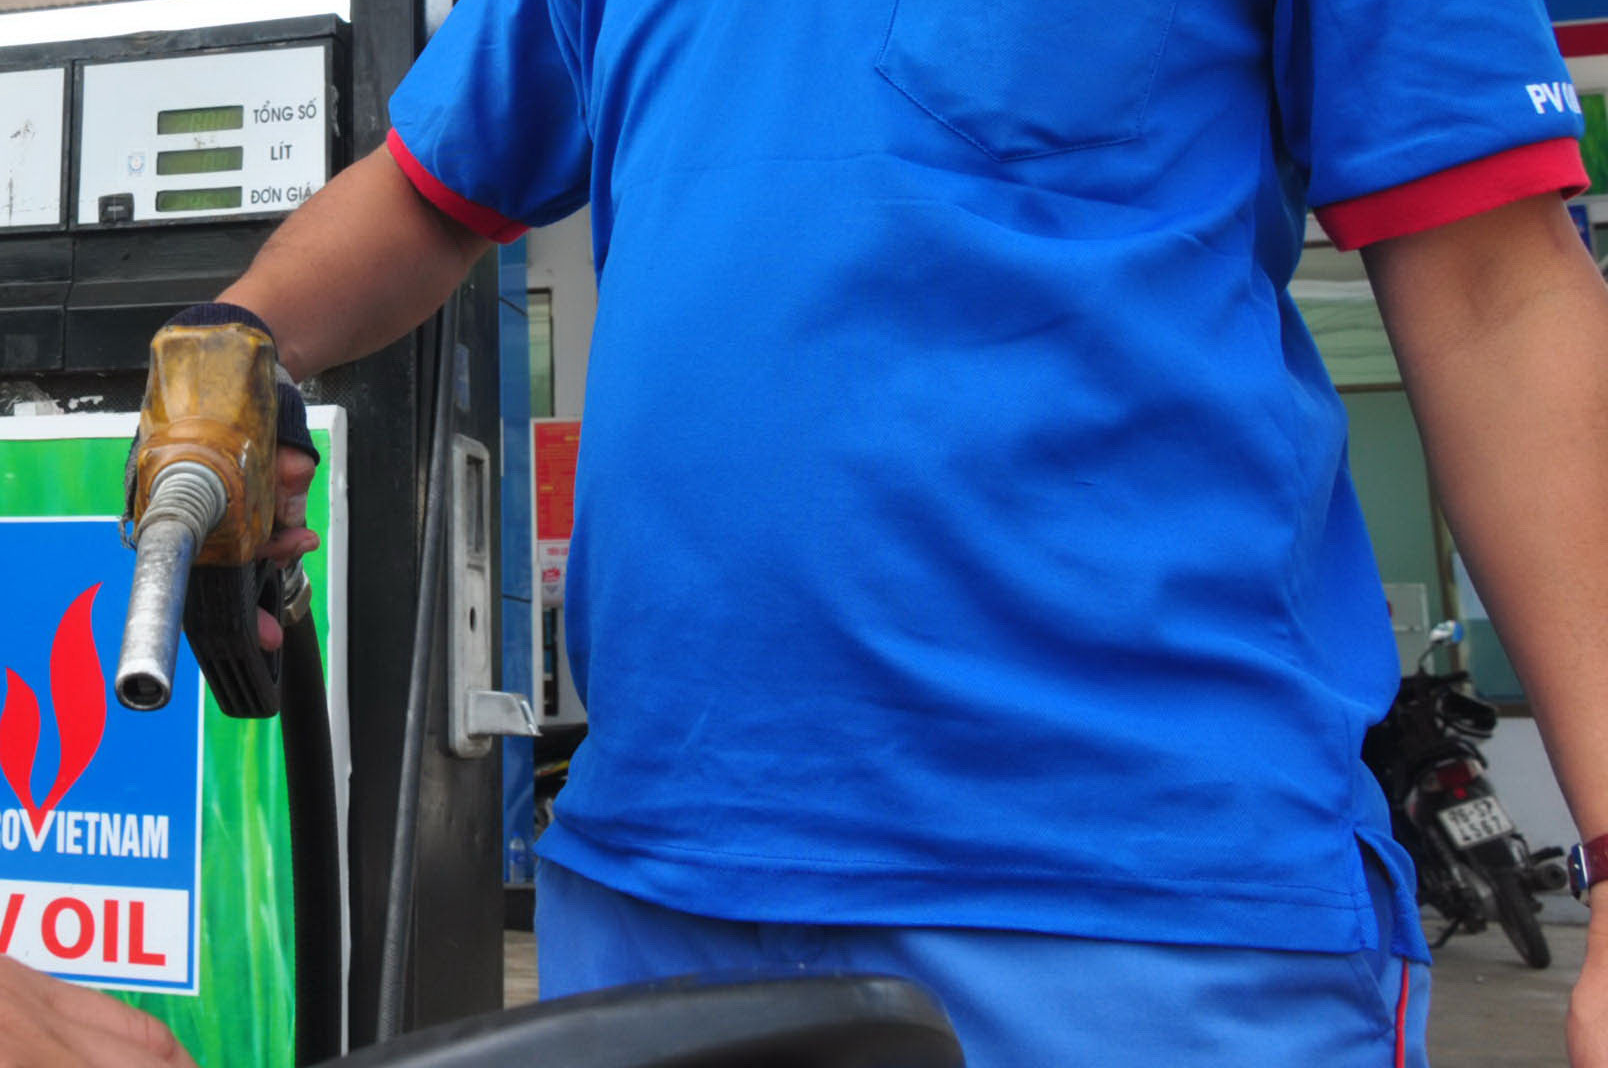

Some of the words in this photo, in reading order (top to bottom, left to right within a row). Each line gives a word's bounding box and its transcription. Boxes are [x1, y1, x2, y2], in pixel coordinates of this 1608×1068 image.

[253, 100, 294, 125] TỔNG
[298, 97, 318, 119] SỐ
[1525, 81, 1564, 114] PV
[270, 140, 293, 161] LÍT
[250, 185, 281, 205] ĐƠN
[41, 896, 166, 967] OIL
